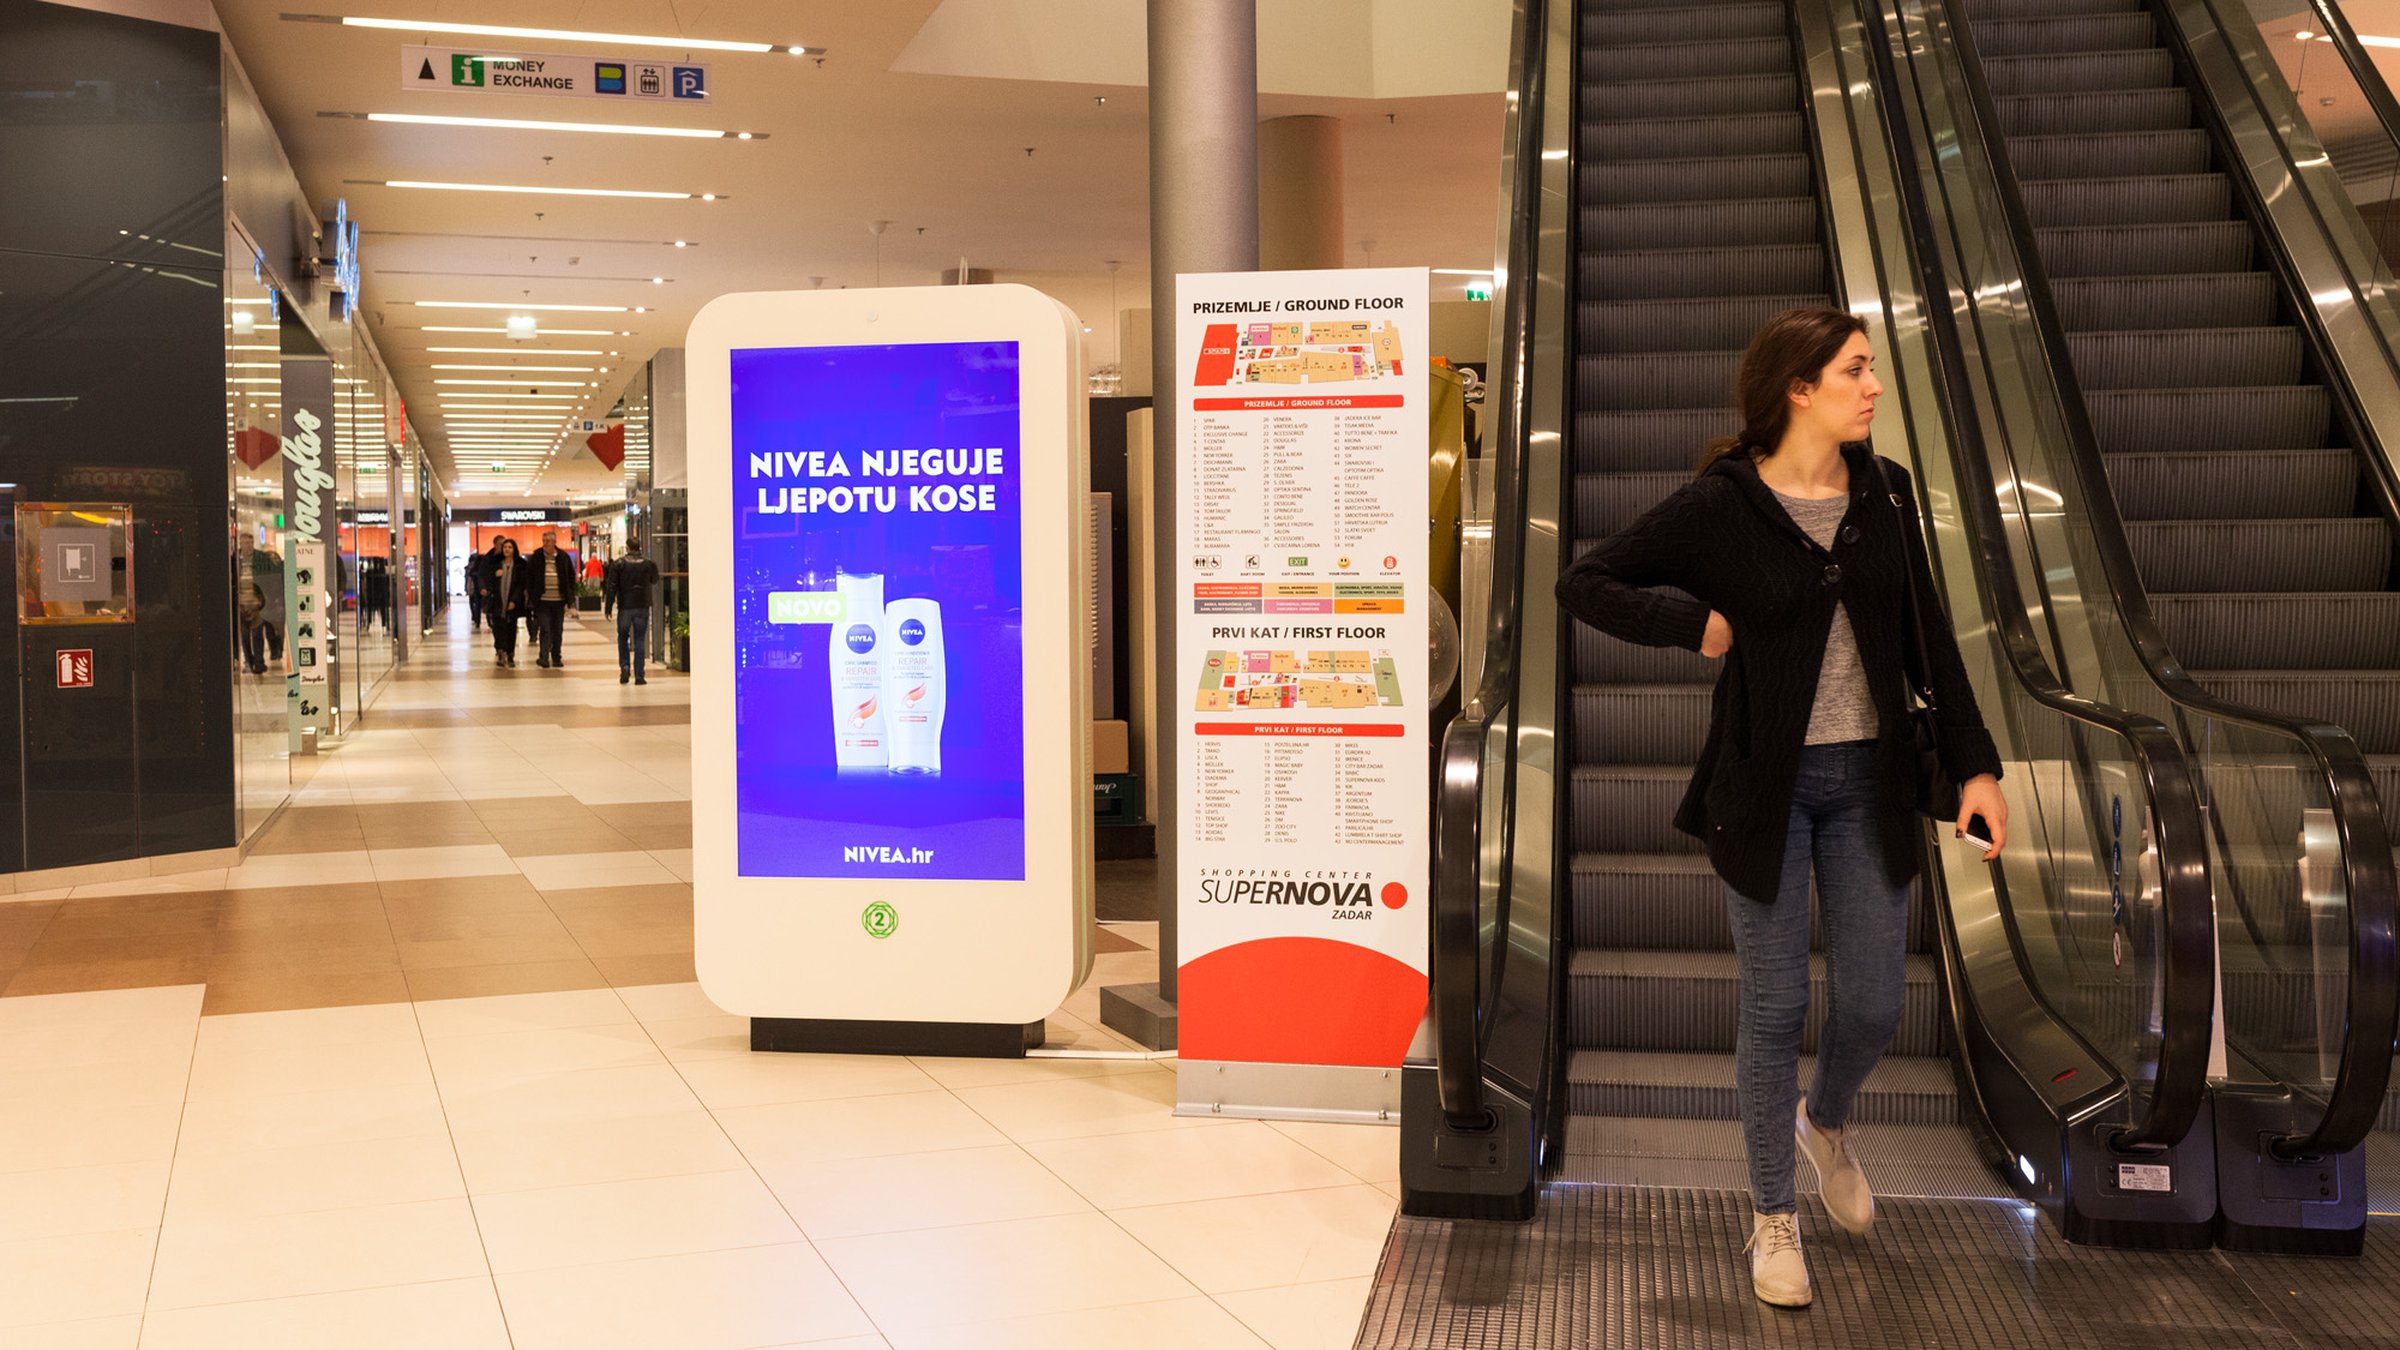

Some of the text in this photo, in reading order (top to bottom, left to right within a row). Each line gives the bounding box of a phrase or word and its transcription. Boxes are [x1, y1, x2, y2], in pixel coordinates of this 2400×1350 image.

[492, 60, 545, 73] MONEY
[492, 74, 574, 90] EXCHANGE
[1193, 301, 1271, 314] PRIZEMLJE
[1285, 299, 1350, 312] GROUND
[1355, 298, 1404, 310] FLOOR
[750, 448, 1004, 478] NIVEA NJEGUJE
[281, 408, 335, 541] ouglas
[758, 485, 996, 514] LJEPOTU KOSE
[501, 511, 545, 521] SWAROVSKI
[776, 600, 841, 618] NOVO
[1212, 628, 1245, 638] PRVI
[1251, 628, 1280, 638] KAT
[1293, 627, 1332, 639] FIRST
[1337, 627, 1386, 639] FLOOR
[844, 846, 934, 864] NIVEA.hr
[1200, 868, 1373, 880] SHOPPING CENTER
[1199, 879, 1373, 906] SUPERNOVA
[875, 912, 885, 926] 2
[1332, 910, 1372, 920] ZADAR
